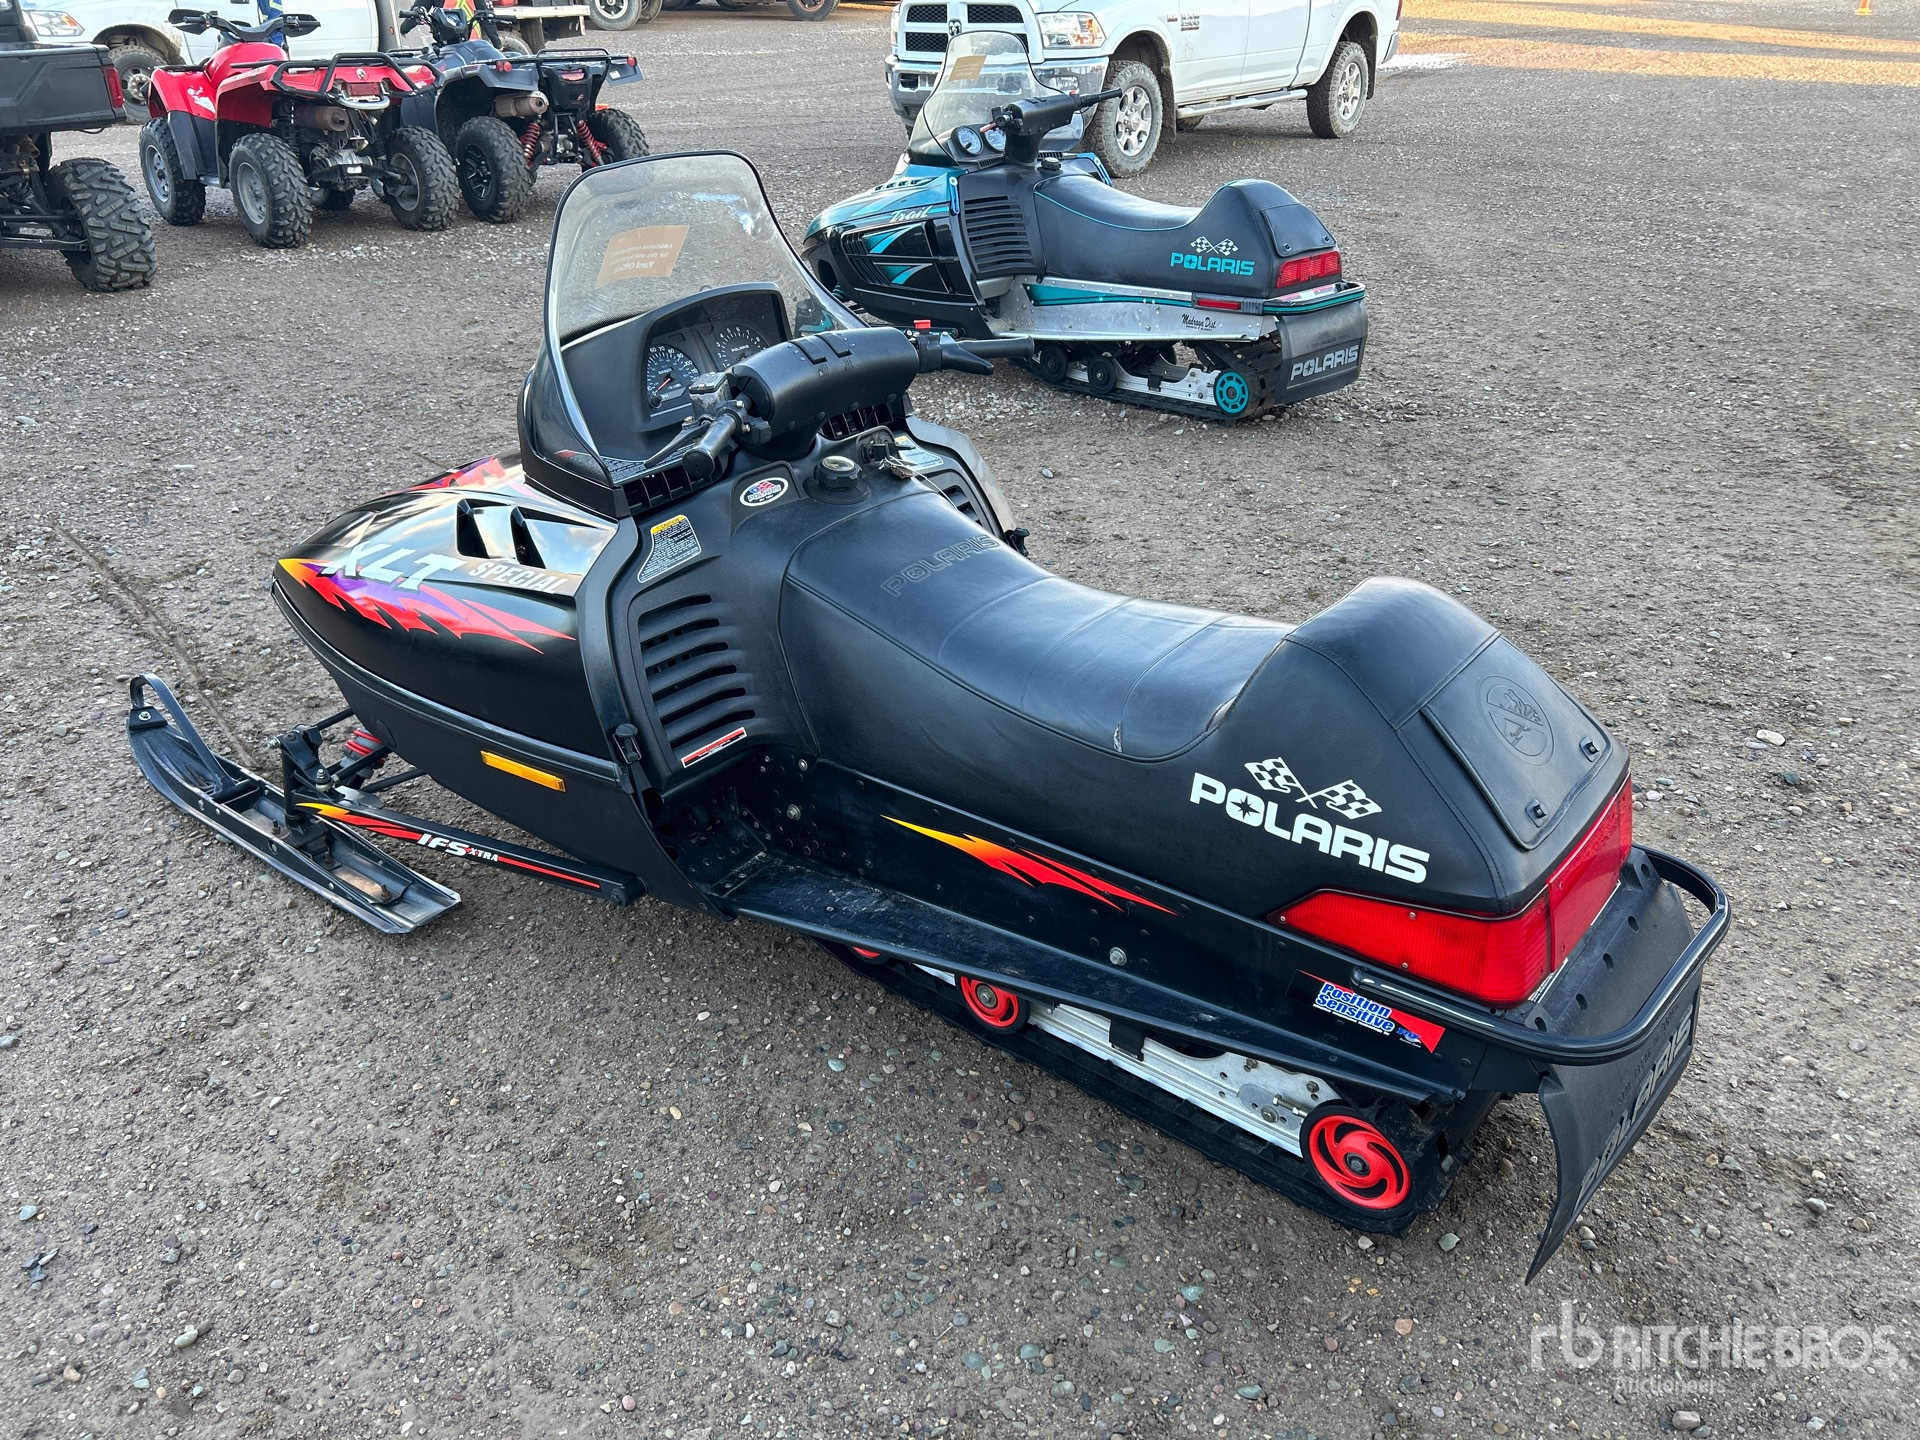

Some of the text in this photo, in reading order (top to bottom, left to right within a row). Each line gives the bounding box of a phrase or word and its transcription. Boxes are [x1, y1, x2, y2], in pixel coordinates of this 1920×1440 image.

[889, 205, 933, 223] Trail
[1170, 252, 1255, 276] POLARIS
[1290, 345, 1359, 381] POLARIS
[661, 518, 680, 528] CAUTION
[321, 540, 568, 594] XLT SPECIAL
[881, 534, 1000, 598] POLARIS
[417, 833, 470, 856] IFS
[1189, 772, 1430, 884] POLARIS
[1315, 992, 1396, 1033] Sensitive
[1320, 982, 1393, 1019] Position
